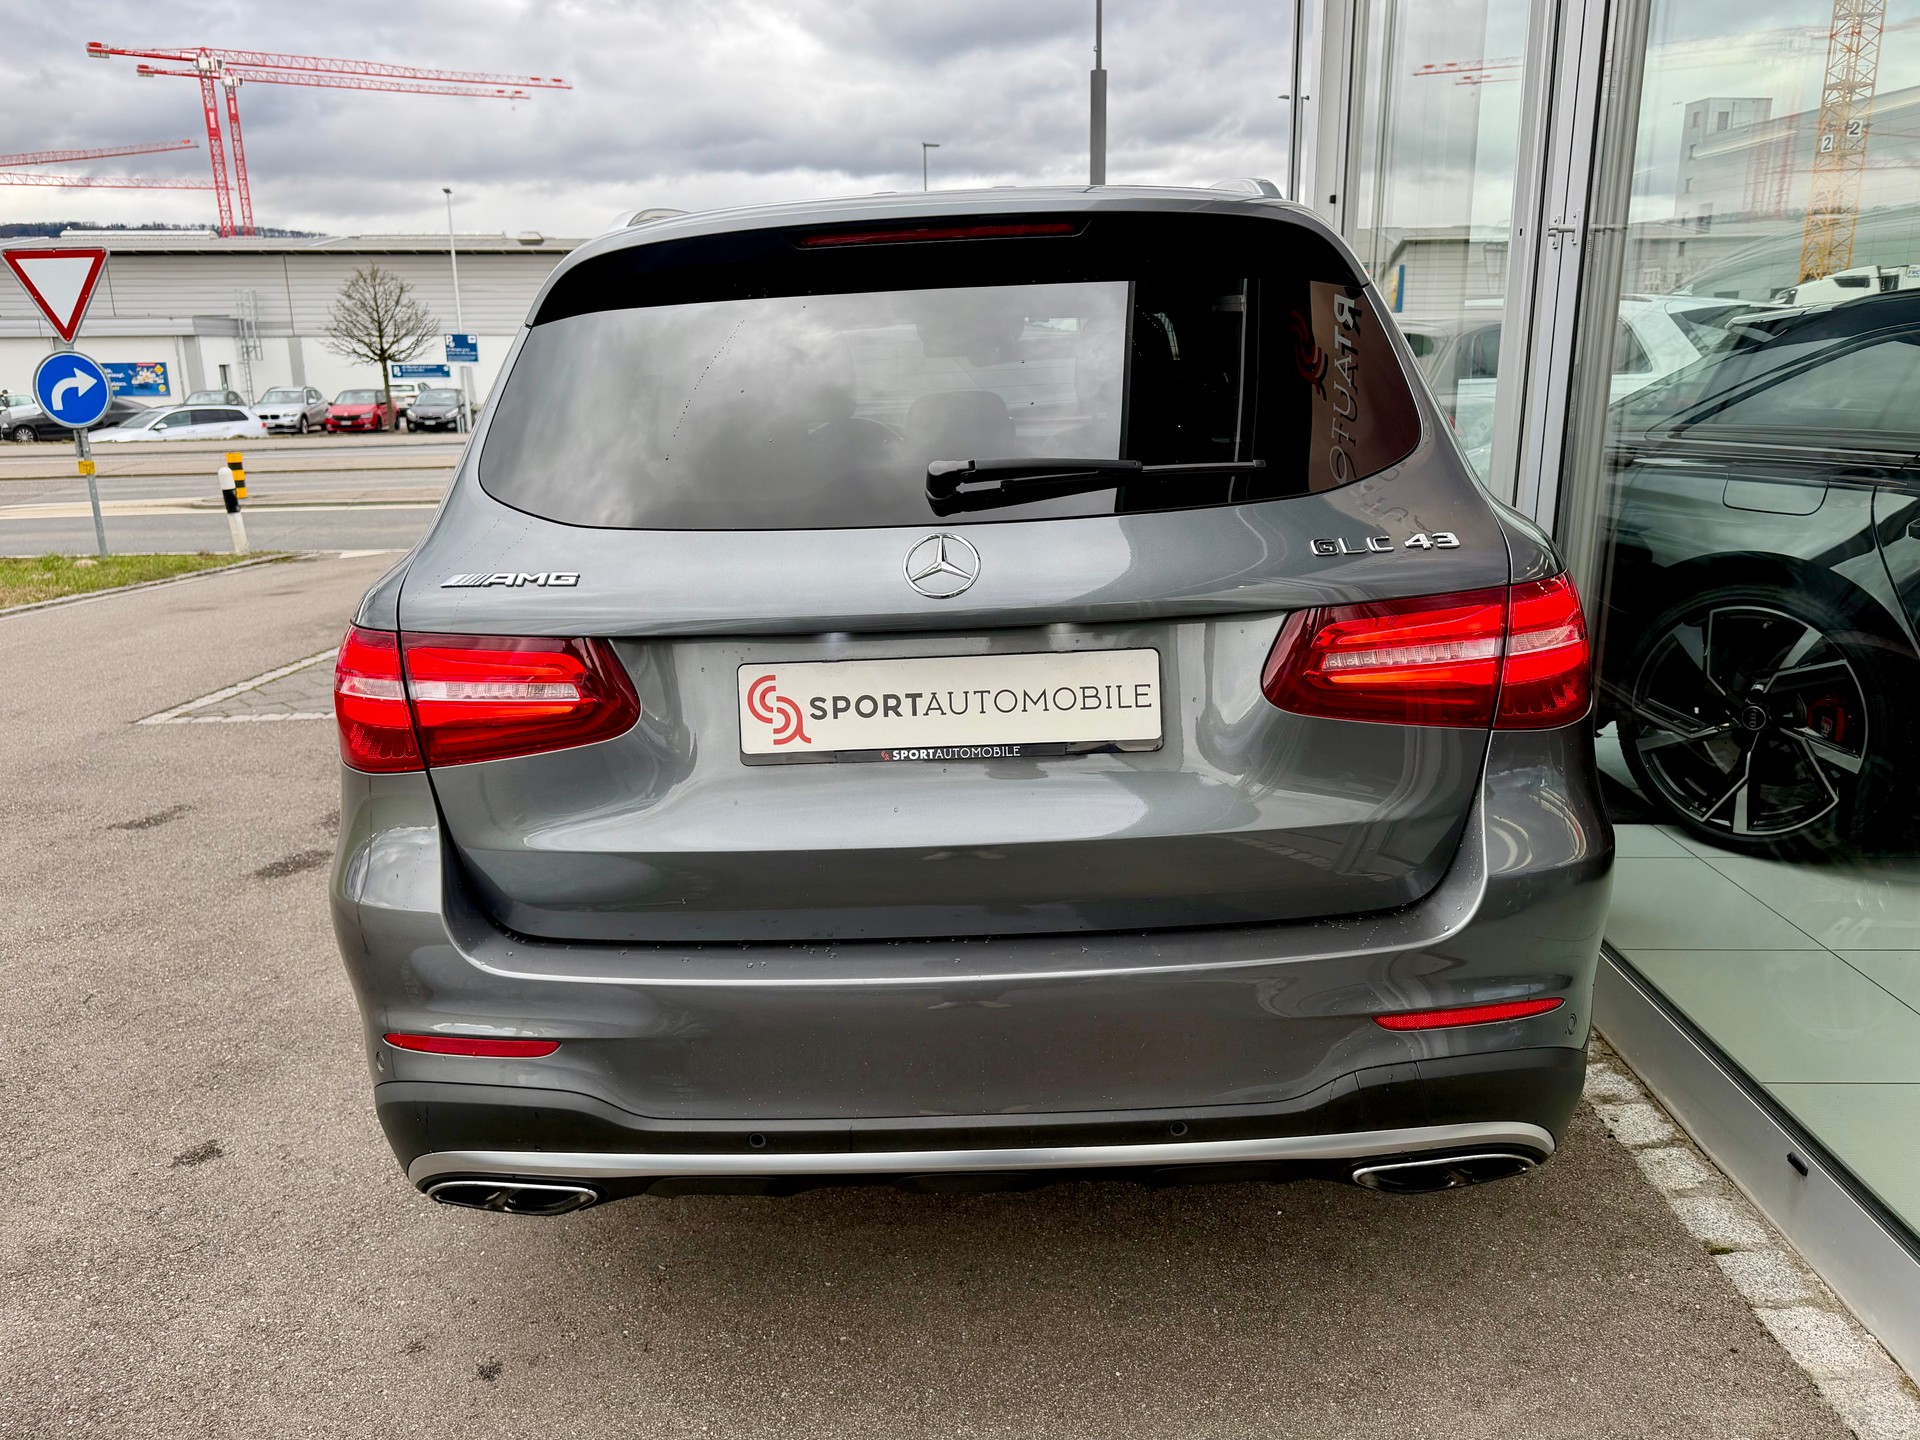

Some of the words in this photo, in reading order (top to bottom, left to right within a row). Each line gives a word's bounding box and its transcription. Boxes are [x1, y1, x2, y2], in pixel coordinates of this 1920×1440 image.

[1849, 122, 1861, 136] 2
[1823, 137, 1832, 151] 2
[1310, 535, 1395, 557] GLC
[1404, 532, 1461, 551] 43
[483, 571, 580, 588] AMG
[809, 683, 1153, 721] SPORTAUTOMOBILE
[892, 745, 1021, 761] SPORTAUTOMOBILE
